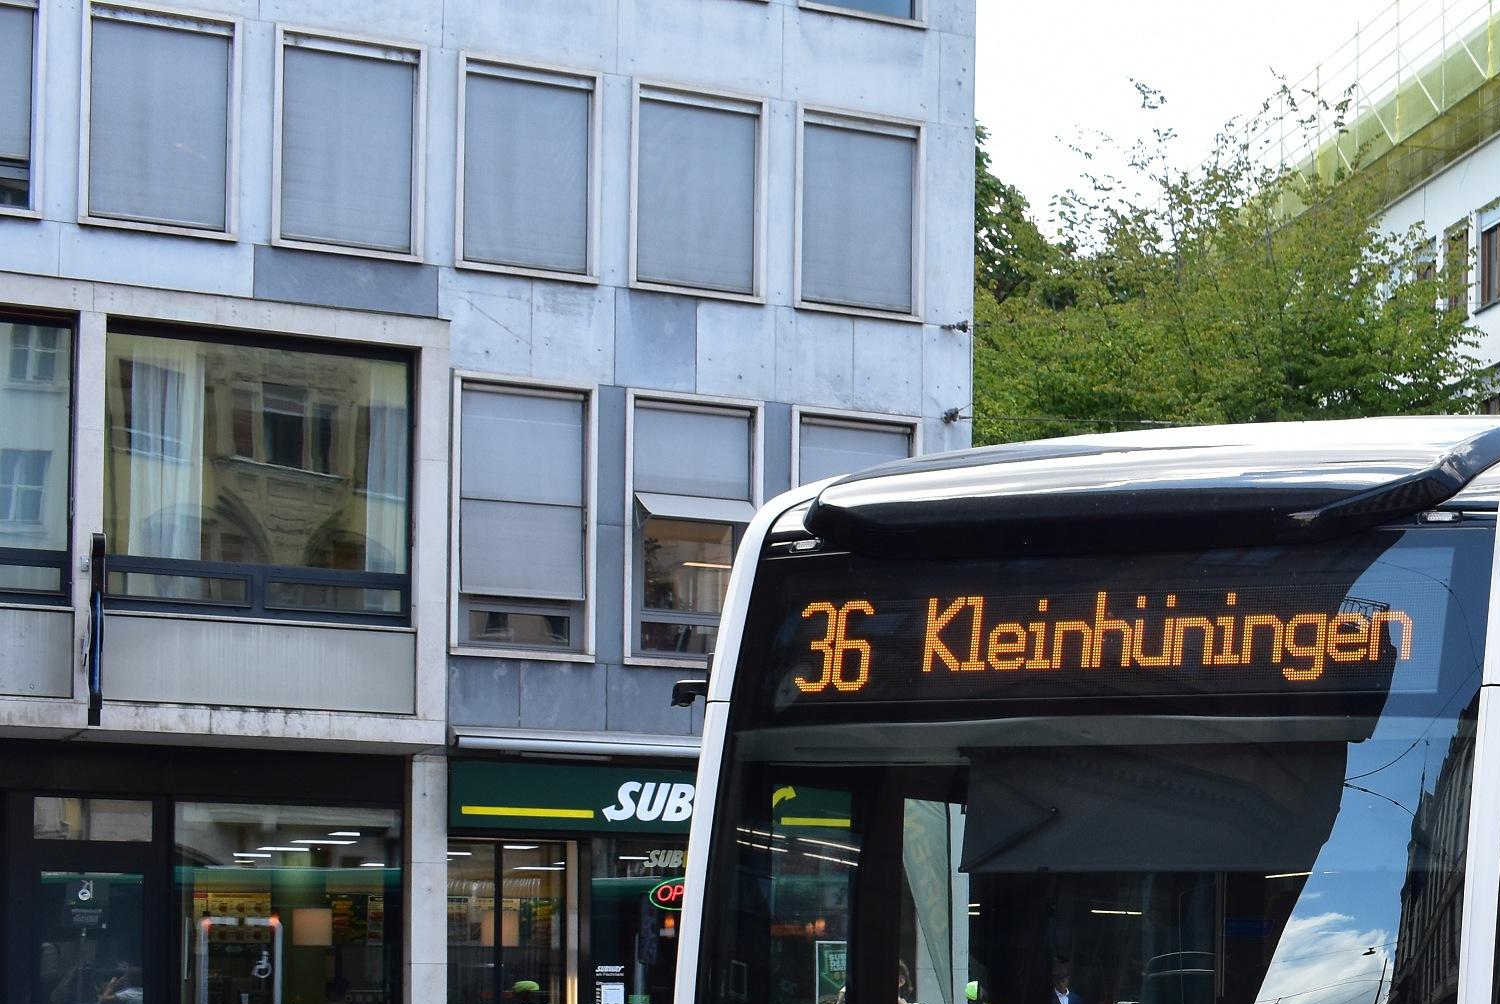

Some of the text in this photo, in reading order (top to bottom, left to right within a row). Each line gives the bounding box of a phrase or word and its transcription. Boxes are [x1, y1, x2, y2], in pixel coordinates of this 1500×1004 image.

[795, 591, 1413, 692] 36 Kleinhüningen
[643, 849, 688, 868] SUB
